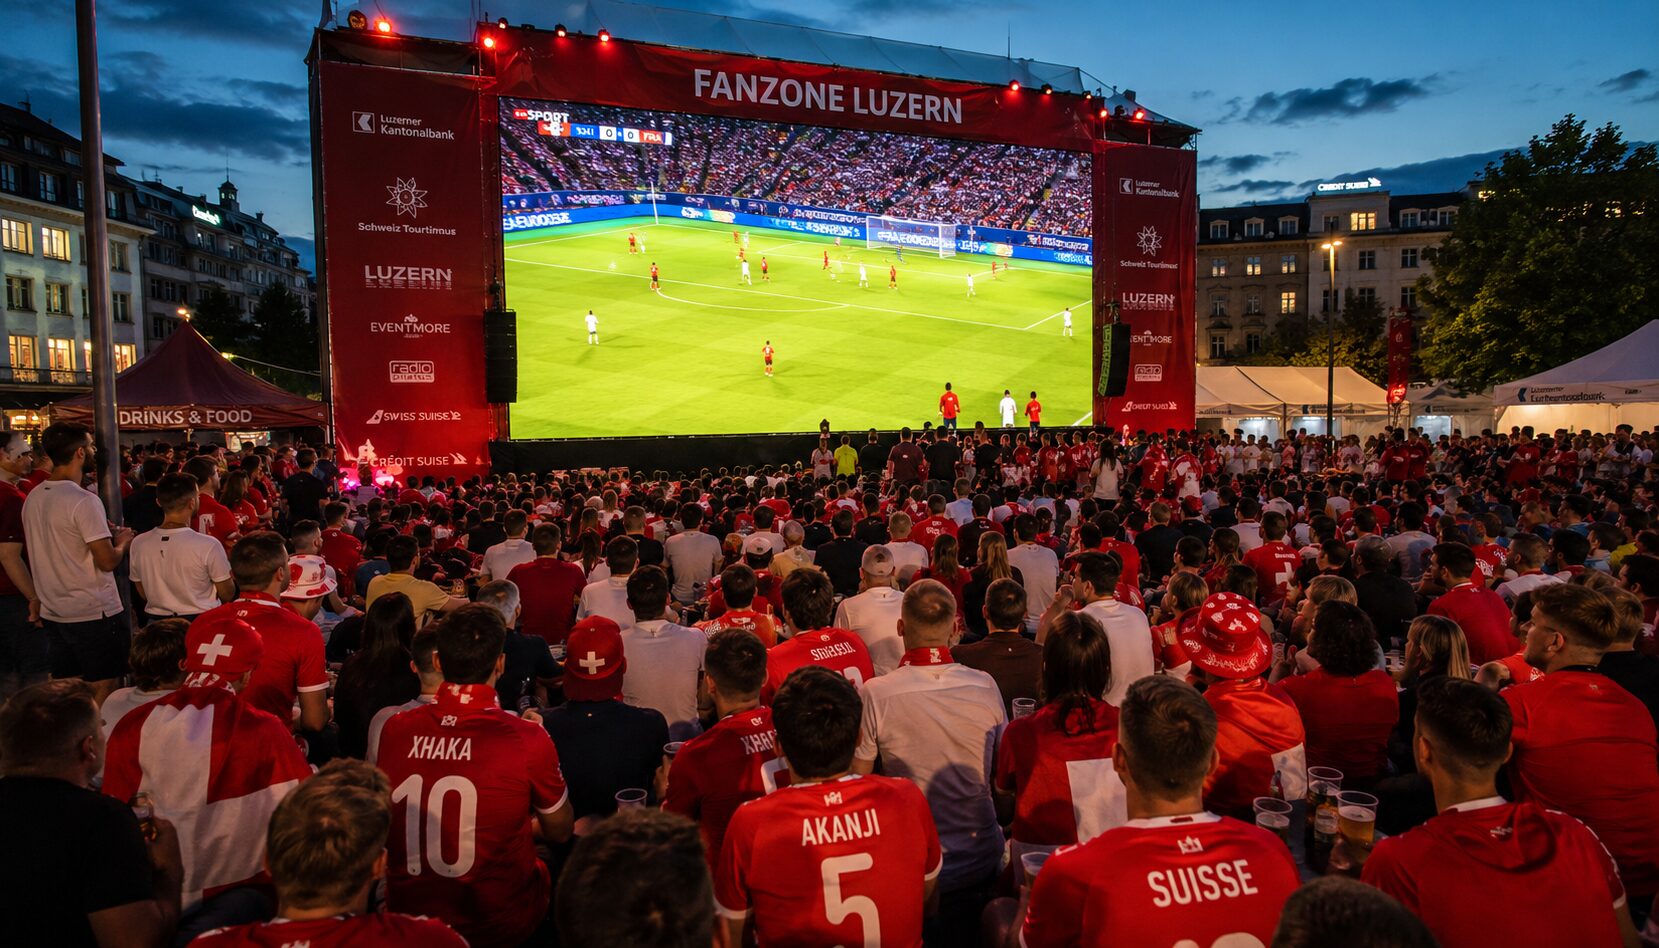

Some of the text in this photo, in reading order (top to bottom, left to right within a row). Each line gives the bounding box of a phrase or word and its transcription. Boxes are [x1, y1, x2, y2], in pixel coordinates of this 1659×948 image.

[694, 68, 962, 124] FANZONE LUZERN
[380, 114, 422, 126] Luzerner
[380, 124, 455, 140] Kantonalbank
[605, 128, 613, 137] 0
[627, 131, 634, 139] 0
[358, 222, 401, 232] Schweiz
[364, 265, 453, 281] LUZERN
[1122, 292, 1175, 304] LUZERN
[370, 322, 451, 333] EVENTMORE
[392, 362, 432, 373] radio
[119, 410, 253, 425] DRINKS & FOOD
[383, 412, 416, 421] SWISS
[407, 735, 472, 761] XHAKA
[391, 773, 478, 878] 10
[801, 808, 881, 847] AKANJI
[1147, 859, 1259, 908] SUISSE
[821, 852, 881, 948] 5
